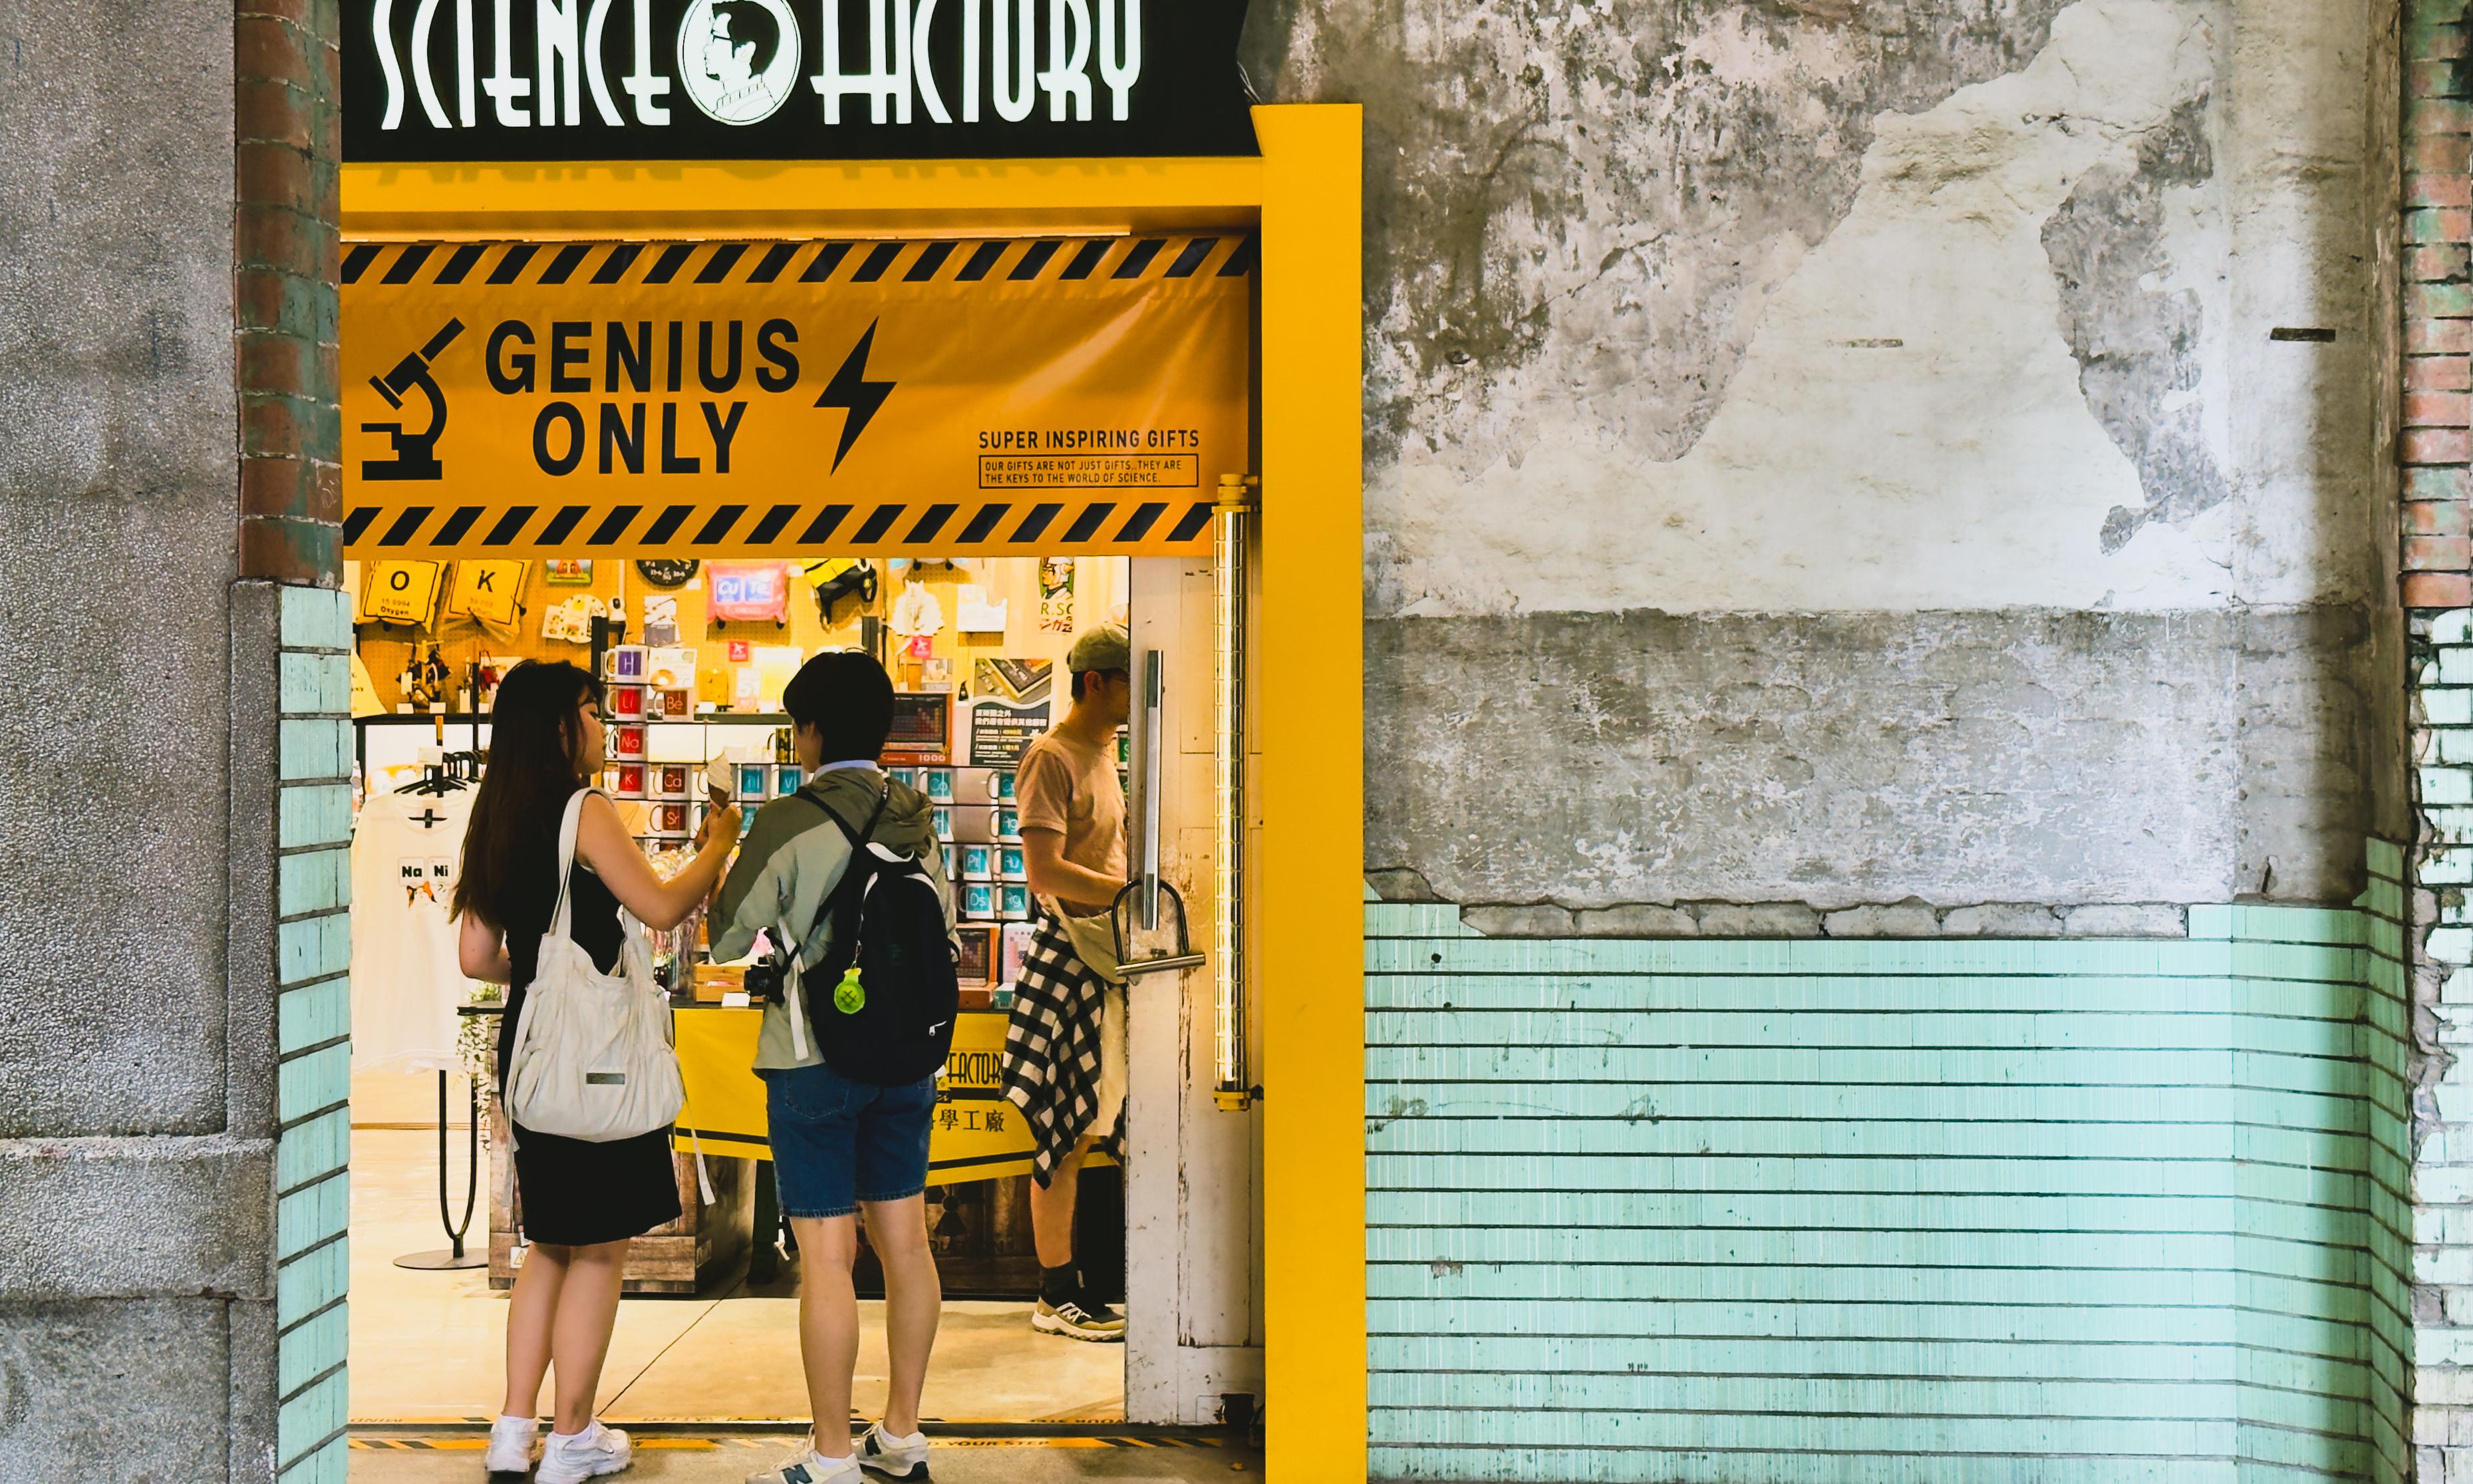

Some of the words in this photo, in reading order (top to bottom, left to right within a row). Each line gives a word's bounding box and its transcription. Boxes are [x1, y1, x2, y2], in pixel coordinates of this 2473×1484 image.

[485, 318, 800, 395] GENIUS
[532, 401, 749, 477] ONLY
[978, 430, 1038, 449] SUPER
[1046, 430, 1141, 448] INSPIRING
[1147, 429, 1200, 448] GIFTS
[985, 461, 1004, 472] OUR
[1007, 460, 1034, 471] GIFTS
[1036, 460, 1054, 471] ARE
[1058, 460, 1076, 470] NOT
[1079, 460, 1101, 470] JUST
[1164, 460, 1182, 470] ARE
[985, 474, 1003, 484] THE
[1006, 473, 1030, 484] KEYS
[1032, 473, 1044, 484] TO
[1047, 473, 1064, 483] THE
[1068, 473, 1100, 483] WORLD
[1103, 473, 1115, 483] OF
[1118, 473, 1161, 483] SCIENCE.
[390, 570, 410, 591] O
[477, 569, 496, 593] K
[380, 606, 409, 616] Oxygen
[624, 656, 634, 672] H
[666, 696, 683, 710] Be
[621, 735, 639, 748] Na
[625, 774, 633, 786] K
[664, 774, 682, 788] Ca
[784, 776, 794, 789] V
[402, 865, 422, 878] Na
[434, 865, 448, 877] Ni
[970, 893, 986, 907] Ds
[946, 1052, 1003, 1085] FACTOR
[931, 1109, 1004, 1132] 學工廠
